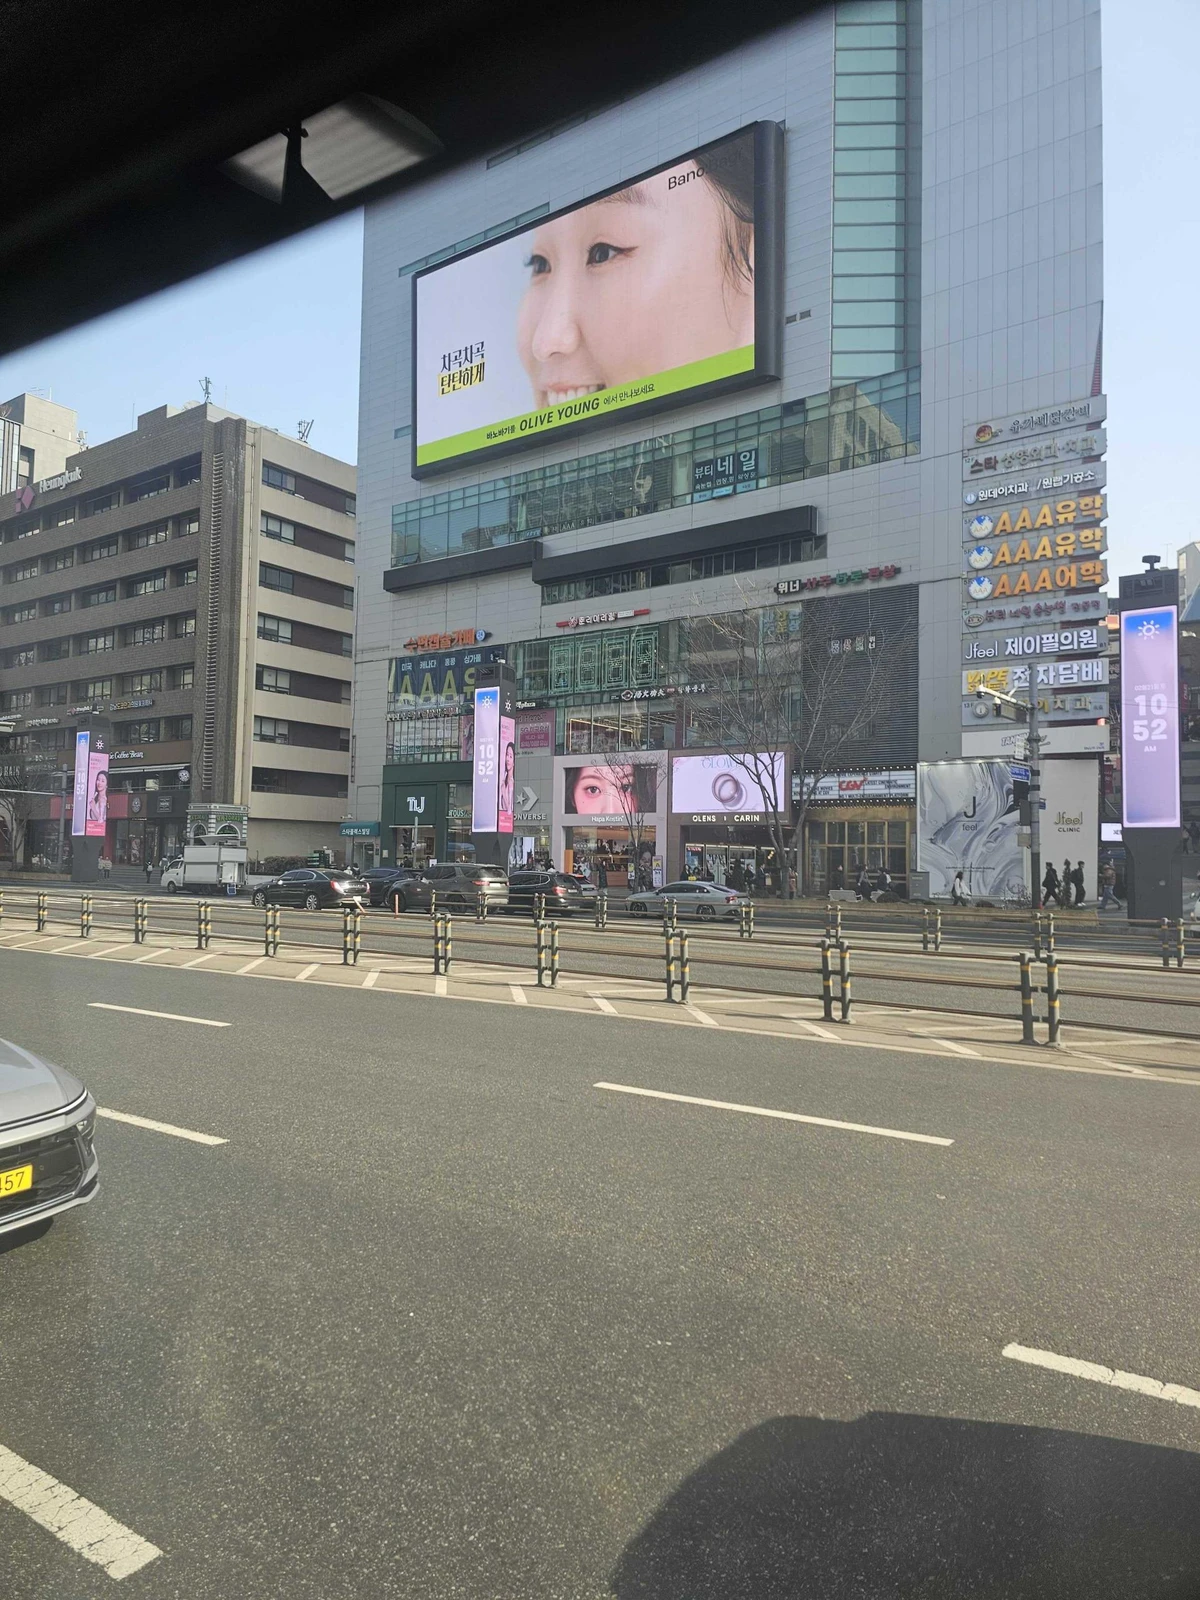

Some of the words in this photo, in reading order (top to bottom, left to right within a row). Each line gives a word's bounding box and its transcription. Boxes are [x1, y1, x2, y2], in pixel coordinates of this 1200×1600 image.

[440, 341, 485, 373] 차곡차곡
[440, 361, 485, 395] 탄탄하게
[486, 424, 516, 440] 바노바기를
[519, 411, 553, 431] OLIVE
[557, 397, 600, 420] YOUNG
[603, 393, 618, 406] 에서
[618, 383, 655, 402] 만나보세요
[694, 464, 713, 479] 뷰티
[717, 450, 756, 475] 네일
[970, 456, 998, 474] 스타
[40, 466, 82, 493] Heungkuk
[978, 482, 1028, 501] 원데이치과
[994, 495, 1104, 535] AAA유학
[993, 527, 1104, 567] AAA유학
[778, 580, 800, 594] 위너
[993, 561, 1104, 598] AAA어학
[965, 641, 998, 659] Jfeel
[1005, 628, 1098, 655] 제이필의원
[967, 669, 1010, 683] VAPE
[1012, 660, 1103, 687] 전자담배
[1134, 693, 1168, 716] 10
[1133, 718, 1168, 741] 52
[479, 744, 494, 759] 10
[77, 772, 85, 783] 10
[478, 760, 494, 775] 52
[76, 785, 85, 795] 52
[839, 777, 868, 791] CGV
[962, 823, 978, 831] feel
[1053, 811, 1083, 826] Jfeel
